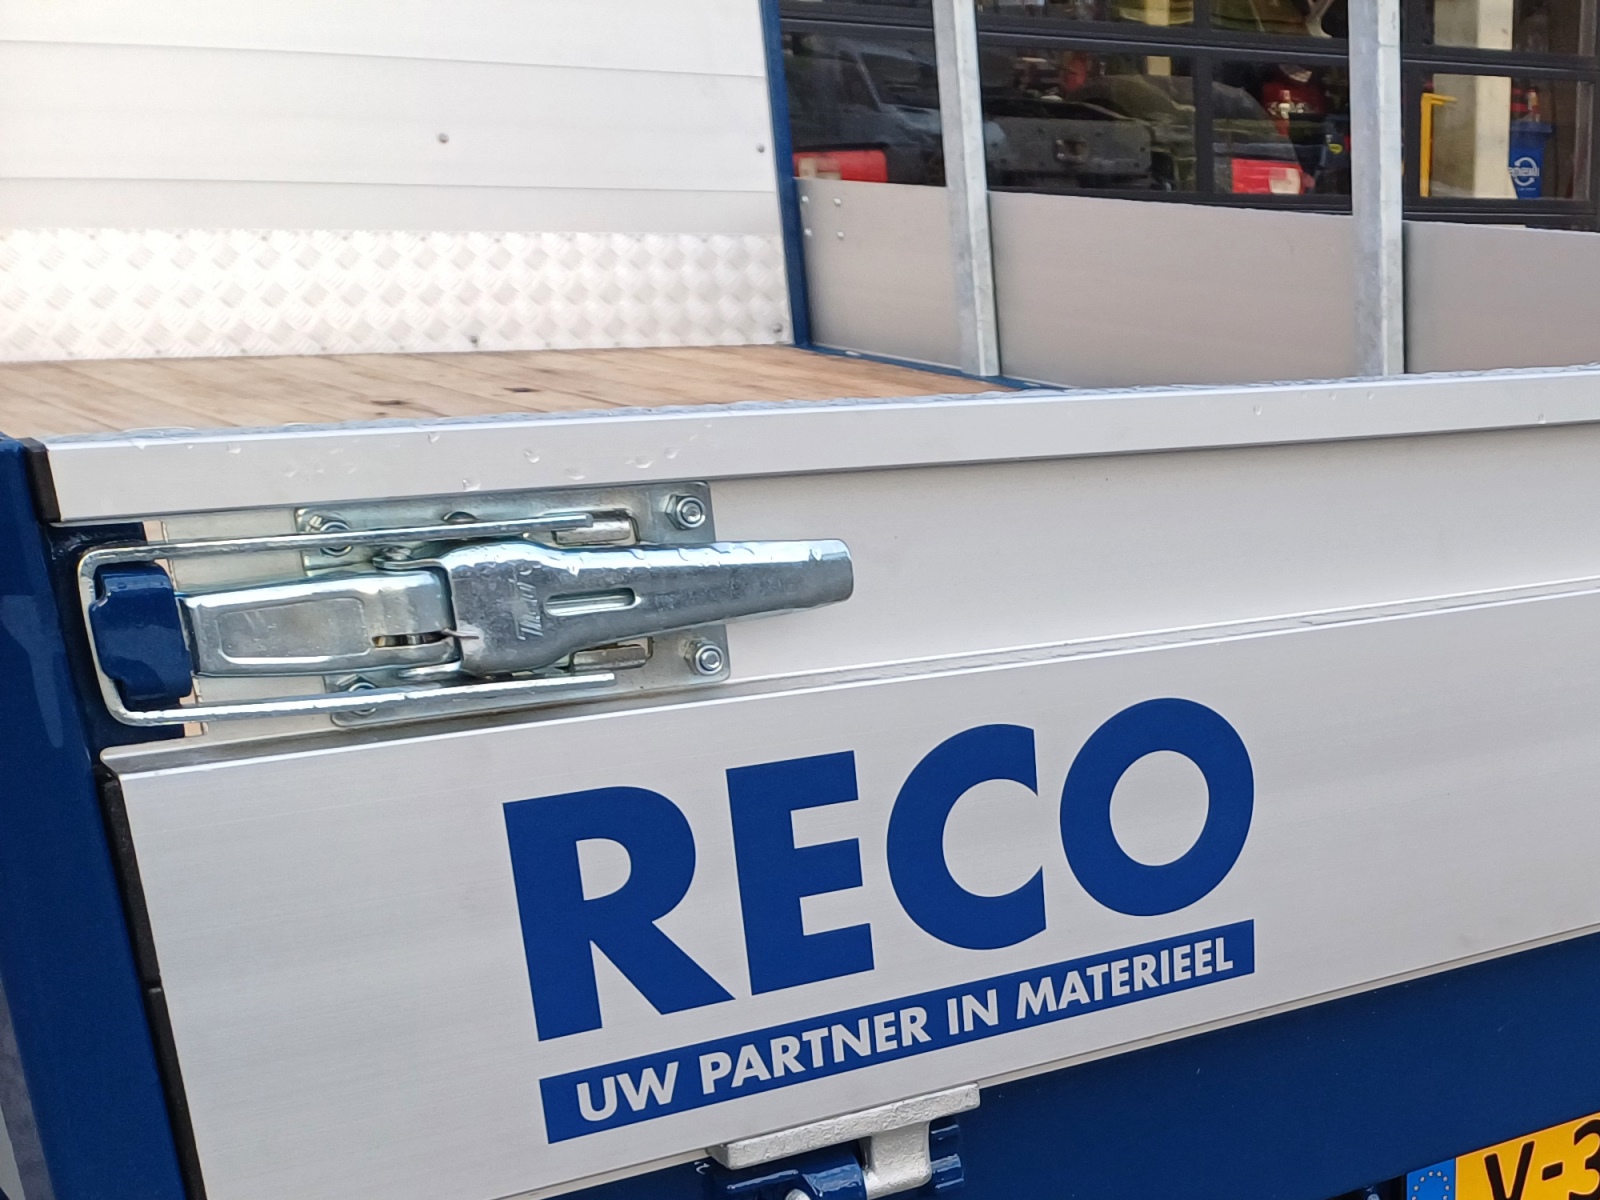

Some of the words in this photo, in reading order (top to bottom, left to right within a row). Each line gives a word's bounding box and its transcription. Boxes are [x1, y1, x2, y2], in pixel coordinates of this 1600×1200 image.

[502, 697, 1254, 1042] RECO
[576, 1061, 680, 1123] UW
[699, 1006, 932, 1095] PARTNER
[947, 989, 999, 1036] IN
[1016, 936, 1234, 1021] MATERIEEL
